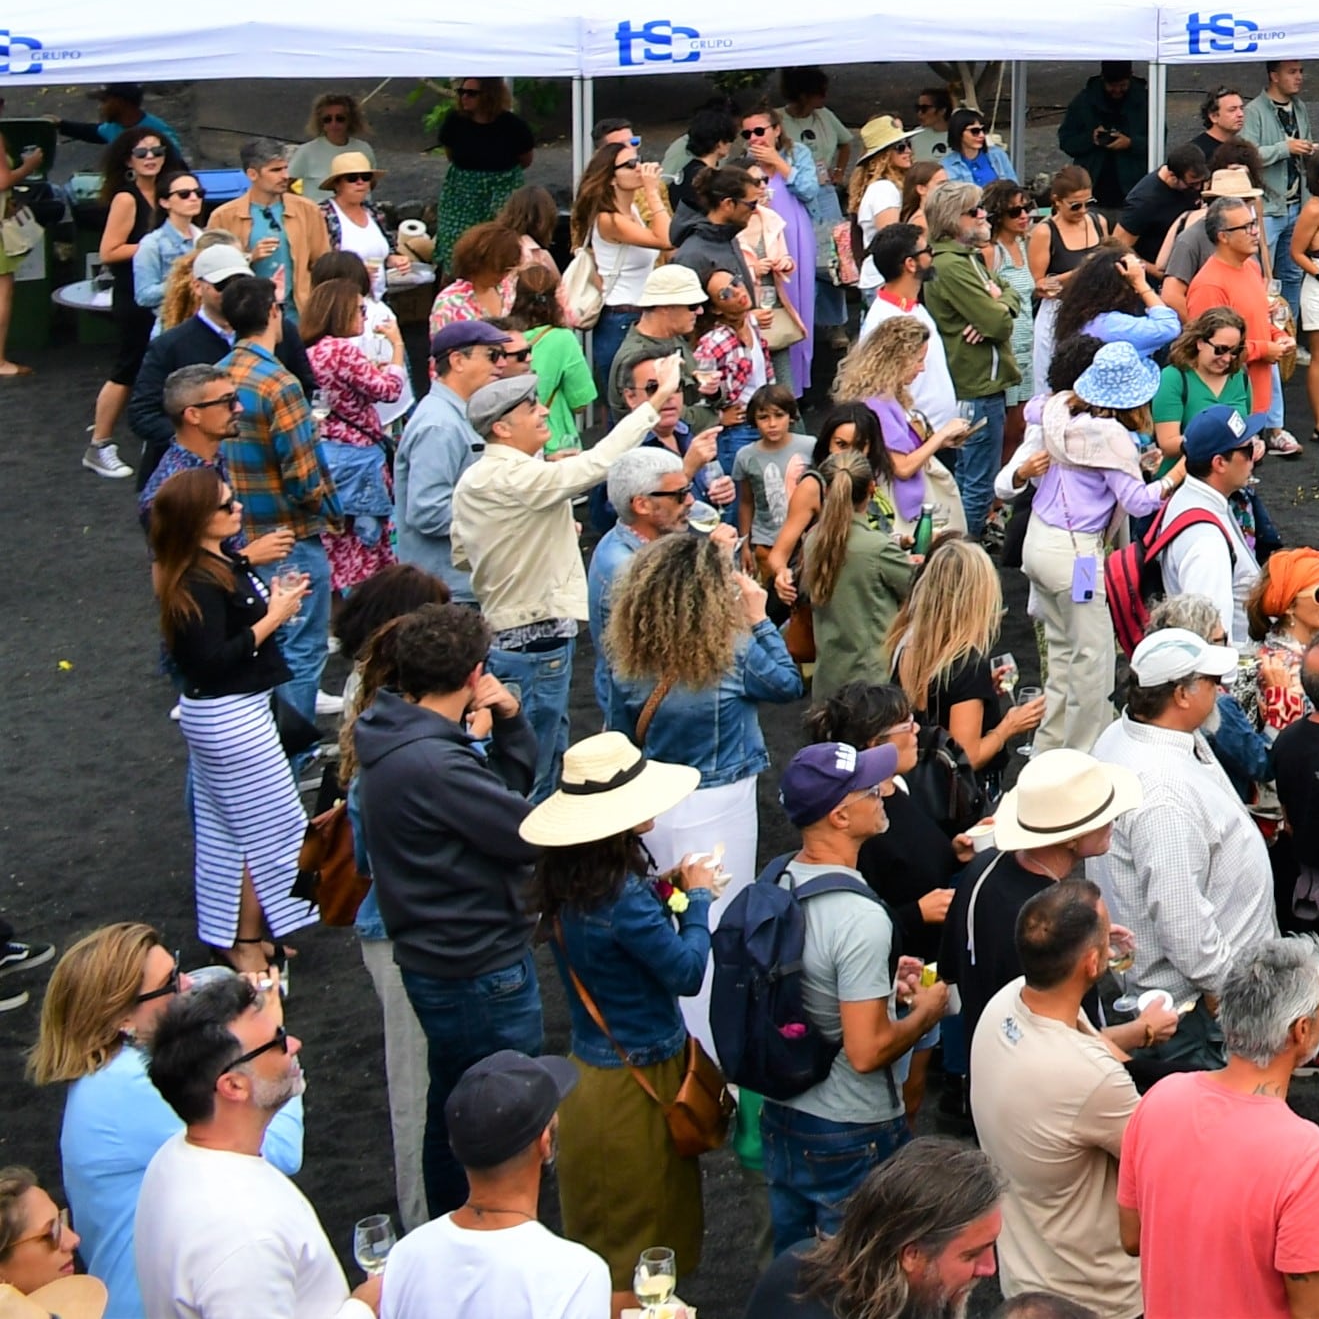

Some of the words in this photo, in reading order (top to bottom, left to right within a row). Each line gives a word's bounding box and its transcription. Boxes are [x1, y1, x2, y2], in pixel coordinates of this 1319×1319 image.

[1248, 31, 1286, 42] GRUPO
[689, 39, 733, 50] GRUPO
[31, 50, 82, 61] GRUPO
